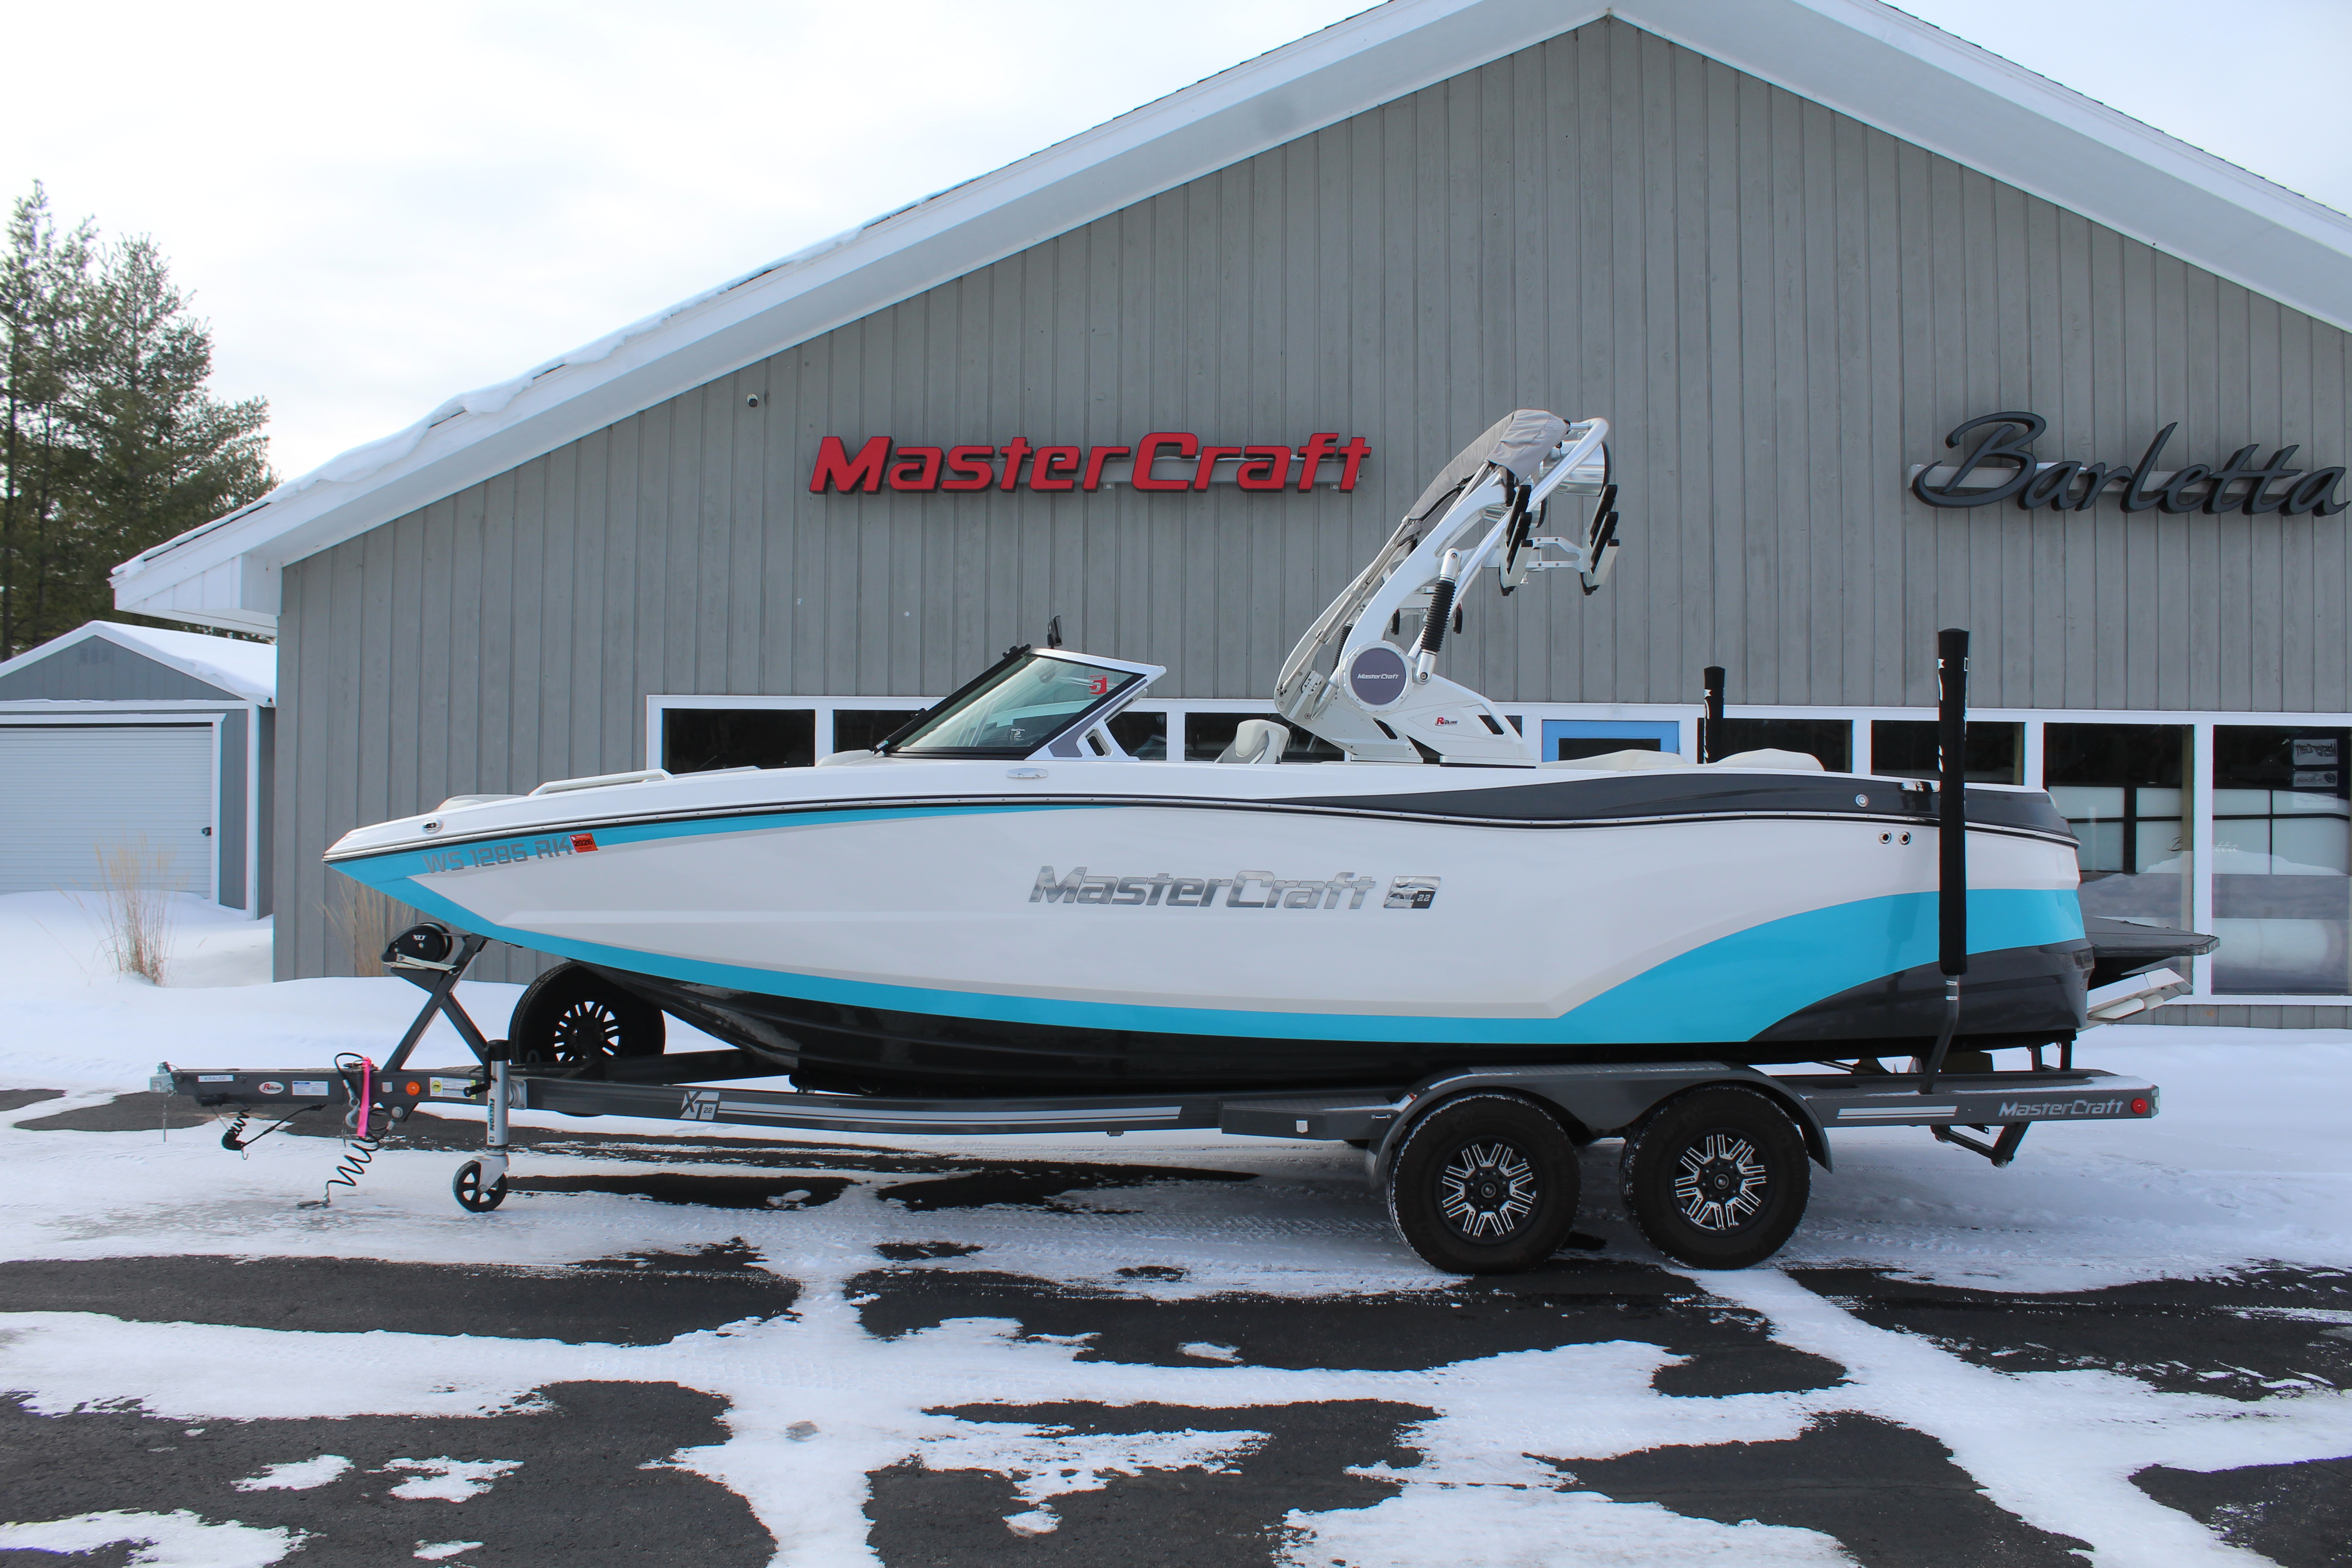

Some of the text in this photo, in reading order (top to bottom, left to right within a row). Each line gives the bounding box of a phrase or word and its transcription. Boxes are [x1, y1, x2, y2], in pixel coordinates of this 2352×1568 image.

[809, 432, 1372, 494] MasterCraft
[1911, 411, 2351, 517] Barletta
[422, 836, 573, 873] WS 1285 RK
[573, 838, 593, 847] 2026
[1029, 866, 1376, 909] MasterCraft
[1999, 1099, 2124, 1117] MasterCraft
